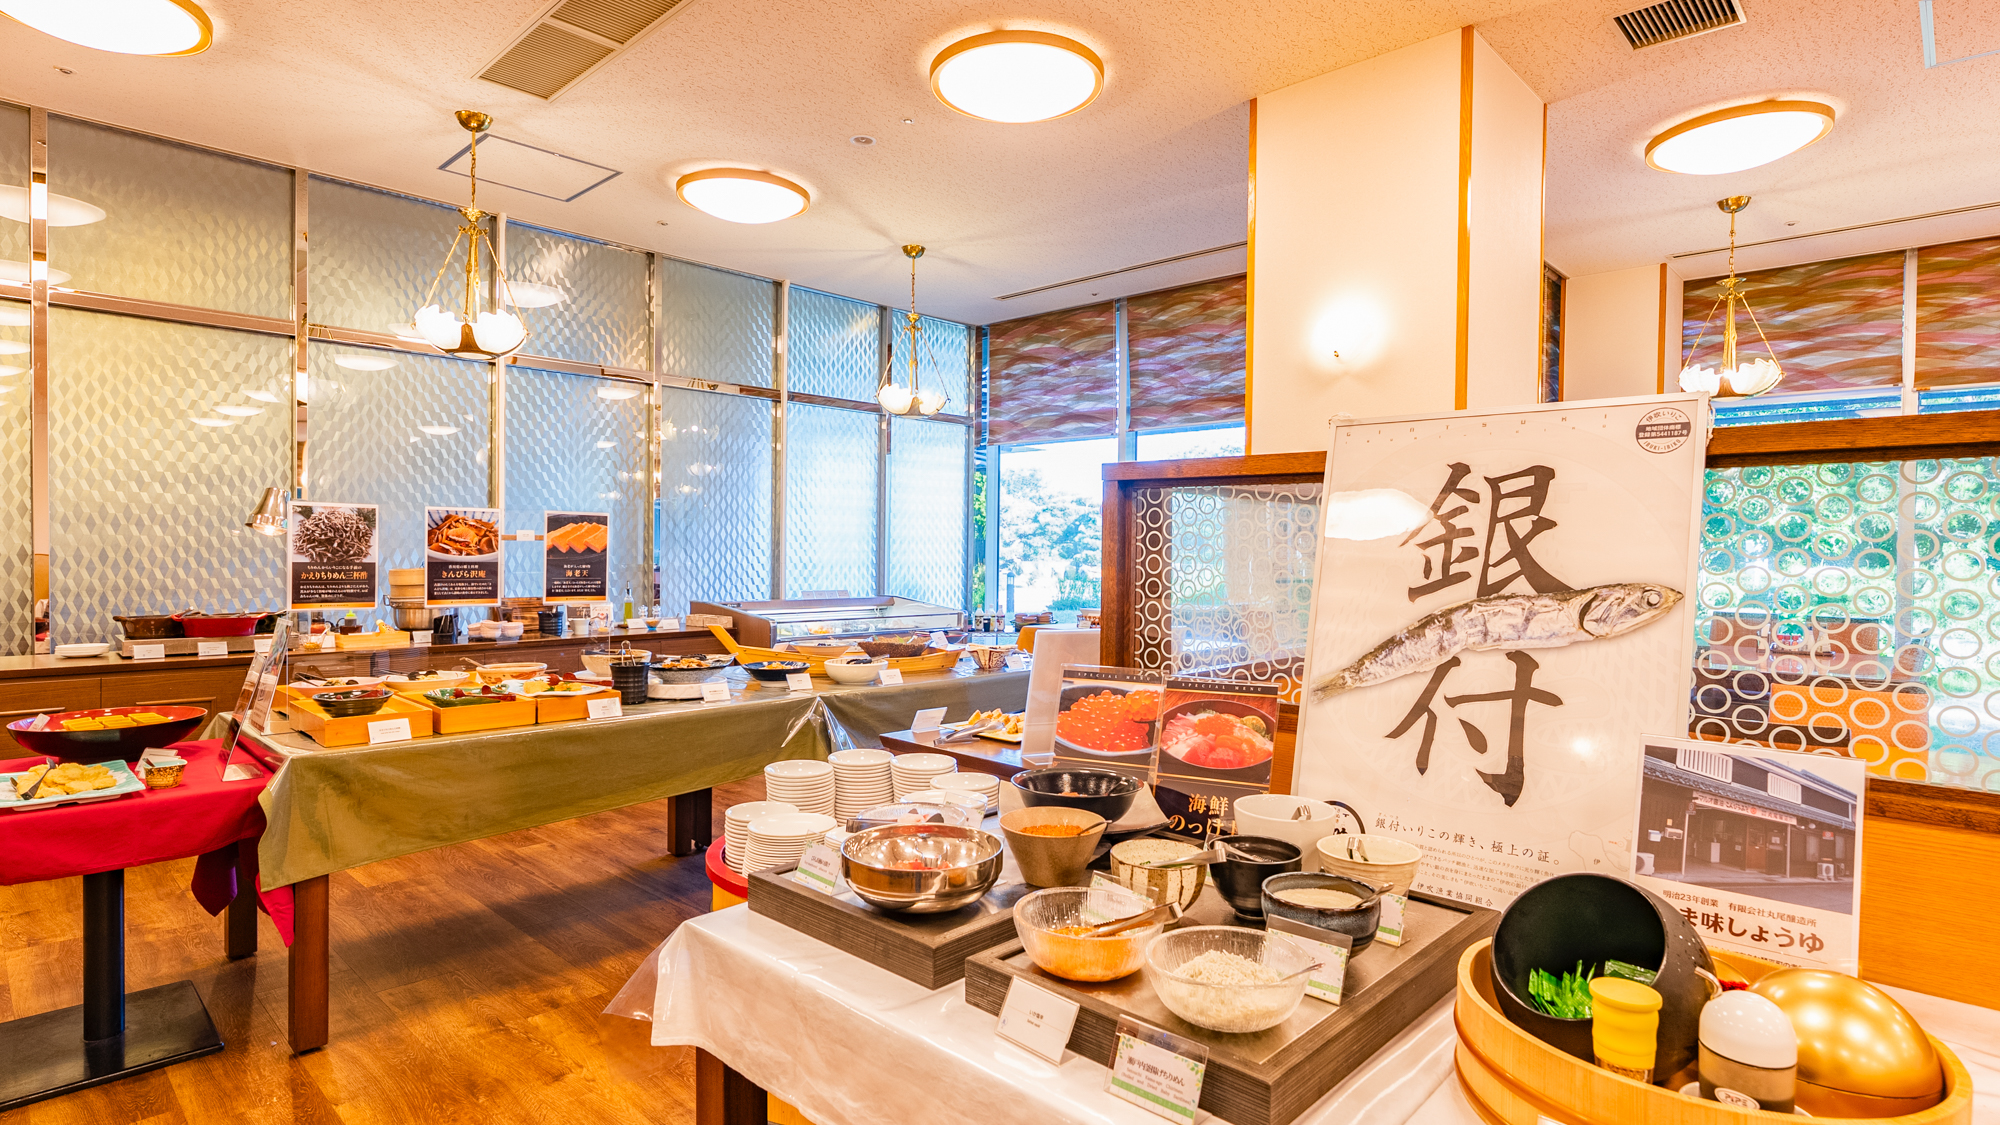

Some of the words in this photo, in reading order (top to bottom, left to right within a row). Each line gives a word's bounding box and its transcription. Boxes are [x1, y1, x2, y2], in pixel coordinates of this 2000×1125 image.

[1646, 411, 1682, 423] 伊吹いりこ
[301, 571, 368, 580] かえりちりめん三杯酢
[441, 570, 487, 578] きんぴら沢庵
[565, 569, 589, 577] 海老天
[1182, 682, 1226, 690] SPECIAL
[1188, 792, 1229, 817] 海鮮
[1375, 816, 1560, 866] 銀付いりこの輝き、極上の証。
[1662, 889, 1719, 908] 明治23年創業
[1727, 902, 1817, 928] 有限会社丸尾醸造所
